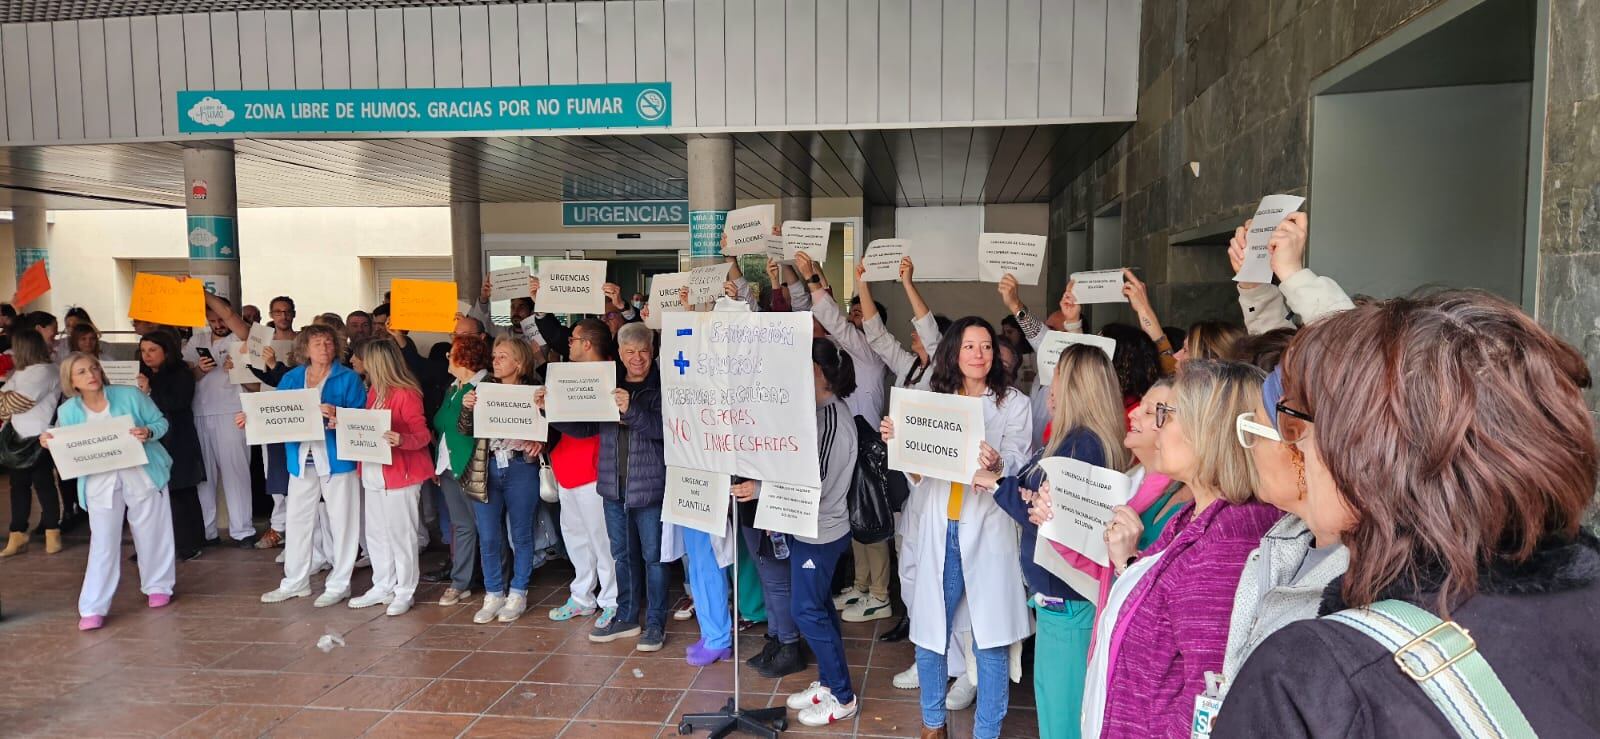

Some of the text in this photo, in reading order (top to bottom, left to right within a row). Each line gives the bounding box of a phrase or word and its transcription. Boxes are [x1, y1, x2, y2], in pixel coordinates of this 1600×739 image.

[245, 97, 623, 119] ZONA LIBRE DE HUMOS. GRACIAS POR NO FUMAR
[573, 206, 682, 223] URGENCIAS
[734, 234, 764, 245] SOLUCIONES
[550, 273, 590, 282] URGENCIAS
[549, 285, 590, 293] SATURADAS
[260, 405, 305, 414] PERSONAL
[486, 400, 532, 409] SOBRECARGA
[265, 417, 305, 425] AGOTADO
[488, 417, 533, 425] SOLUCIONES
[701, 408, 756, 425] ESPERAS
[347, 424, 376, 432] URGENCIAS
[905, 415, 963, 433] SOBRECARGA
[66, 434, 119, 449] SOBRECARGA
[350, 440, 377, 448] PLANTILLA
[703, 432, 799, 452] INNECESARIAS
[905, 440, 959, 458] SOLUCIONES
[74, 450, 122, 463] SOLUCIONES
[678, 499, 711, 513] PLANTILLA
